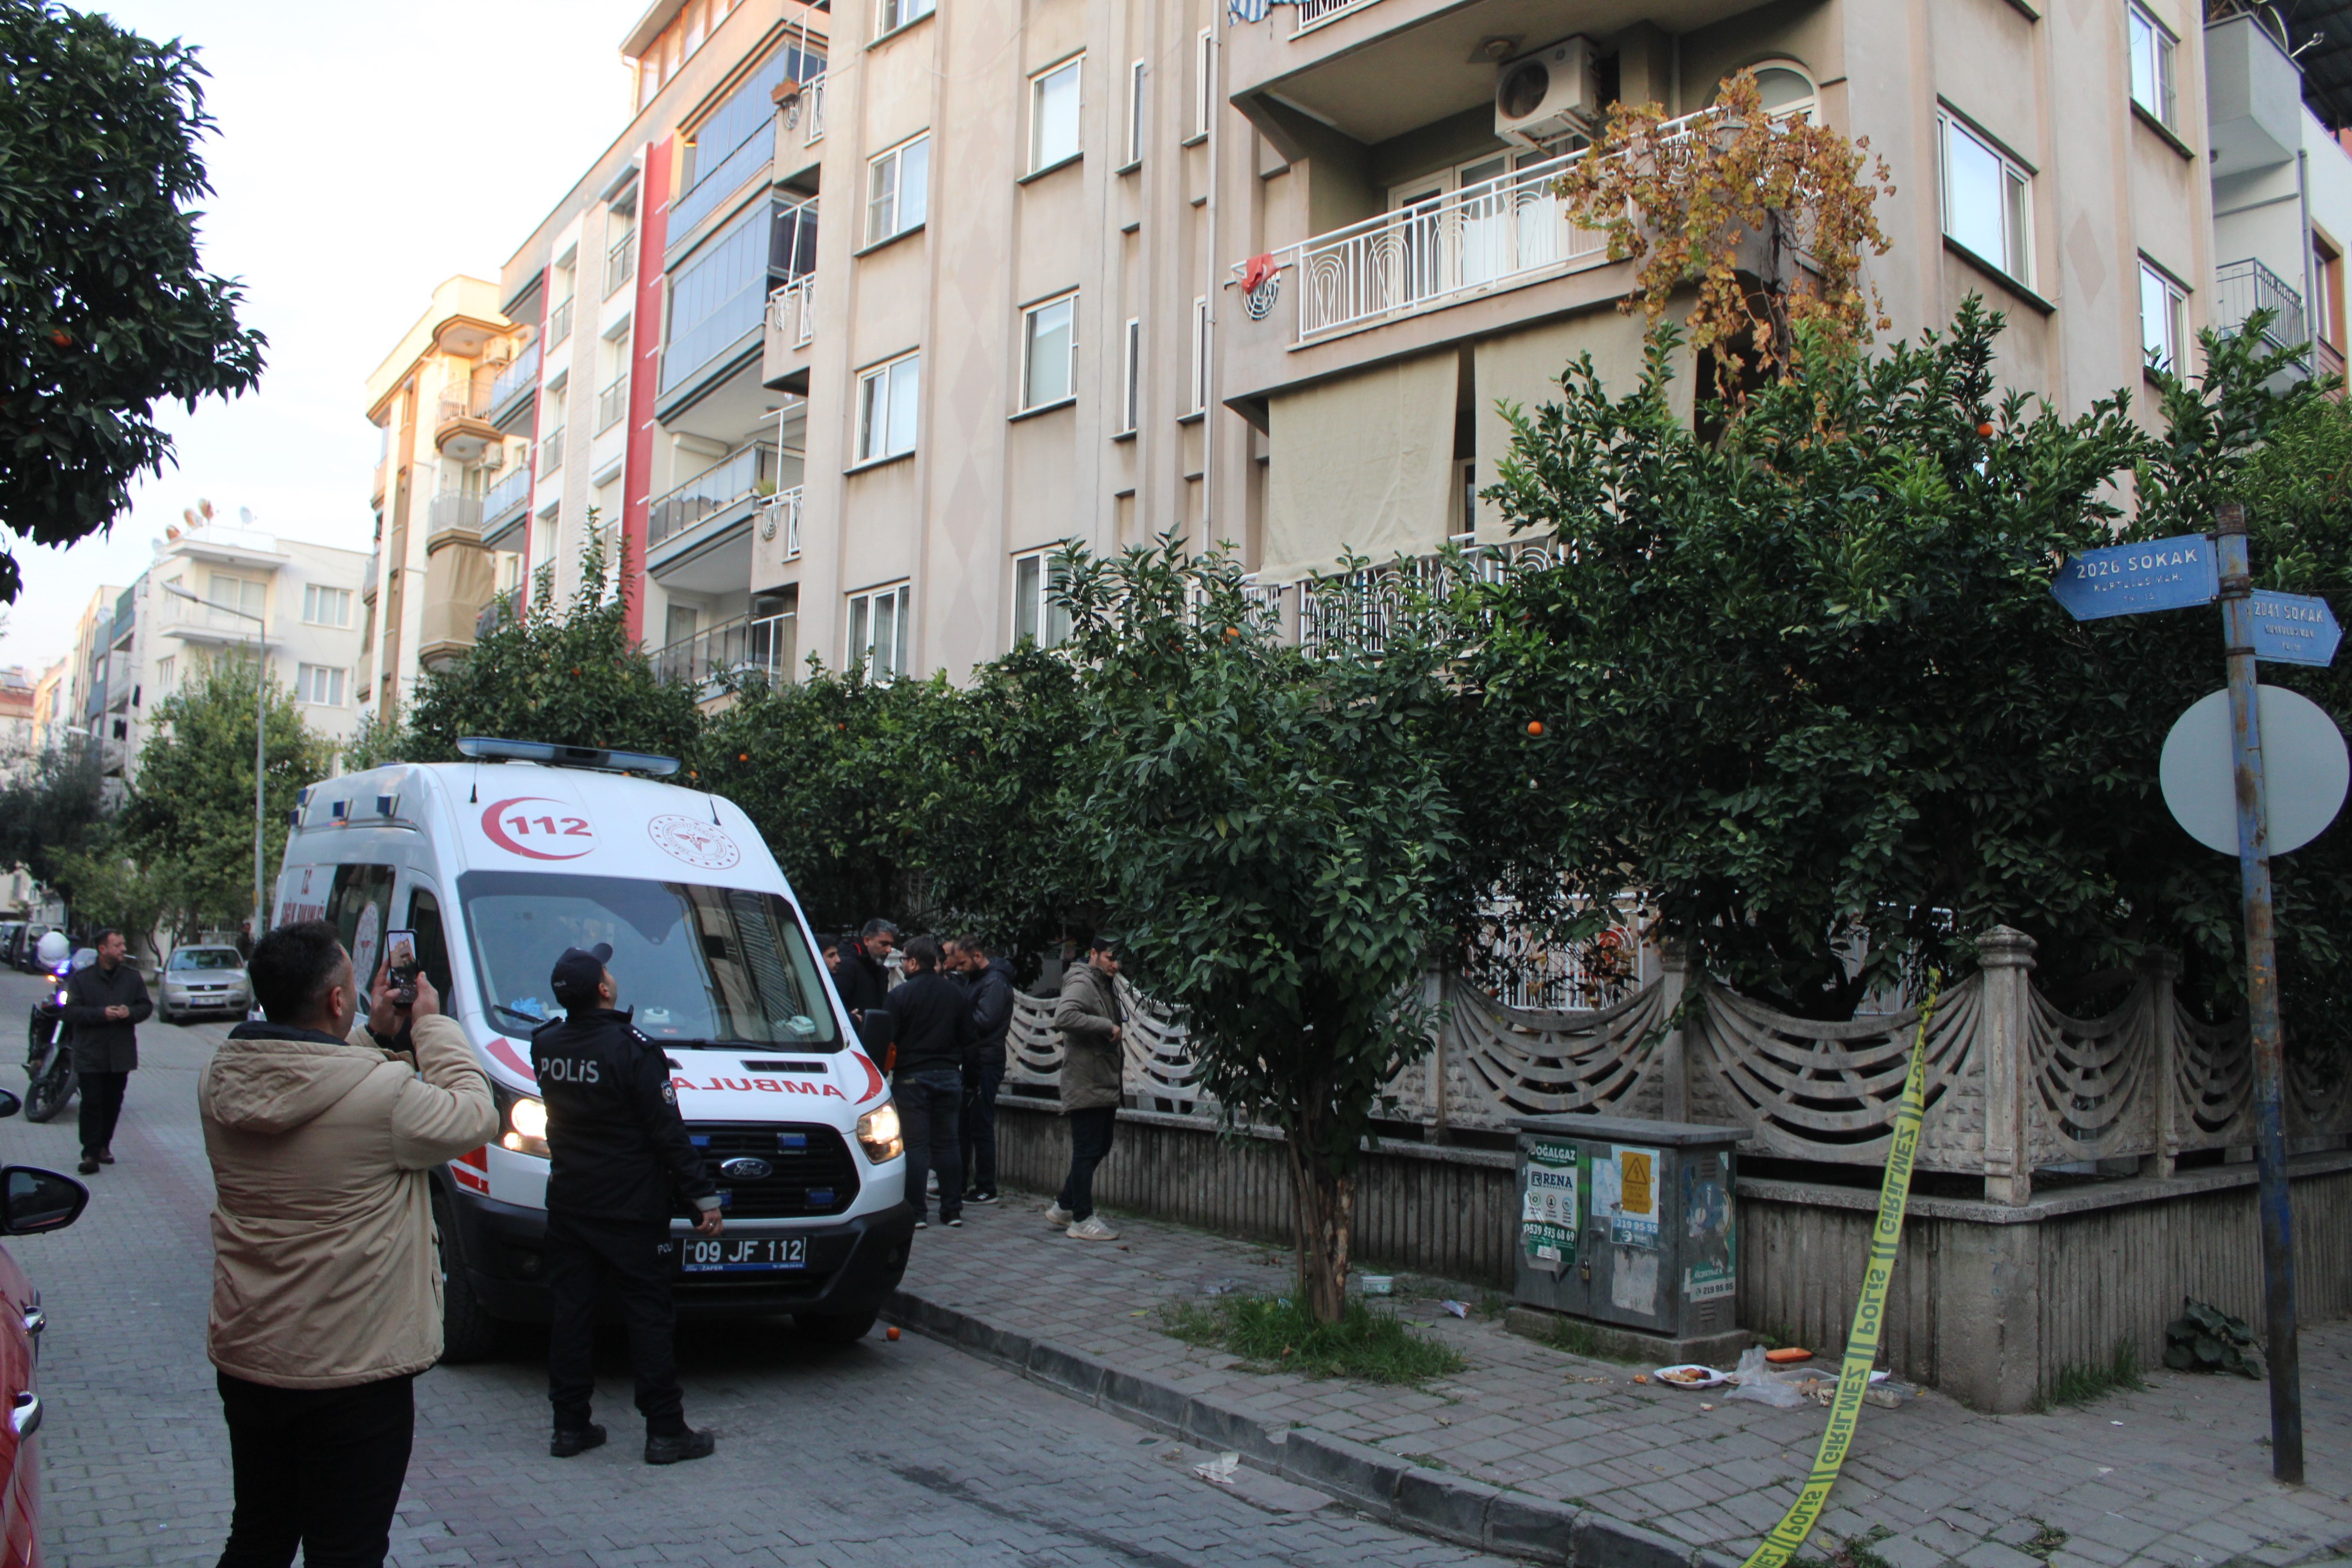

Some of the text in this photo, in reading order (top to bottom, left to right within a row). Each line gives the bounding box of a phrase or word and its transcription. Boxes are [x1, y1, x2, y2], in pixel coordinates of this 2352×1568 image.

[2076, 548, 2197, 579] 2026 SOKAK
[2254, 601, 2324, 623] 2041 SOKAK
[505, 816, 593, 837] 112
[538, 1057, 599, 1083] POLİS
[733, 1162, 762, 1175] Ford
[1543, 1172, 1573, 1188] RENA
[1524, 1223, 1543, 1236] 0539
[1556, 1229, 1565, 1240] 68
[1566, 1230, 1575, 1242] 69
[1616, 1219, 1658, 1233] 219 95 95
[657, 1242, 673, 1255] POL
[694, 1240, 802, 1263] 09 JF 112
[1703, 1282, 1734, 1295] 219 95 95
